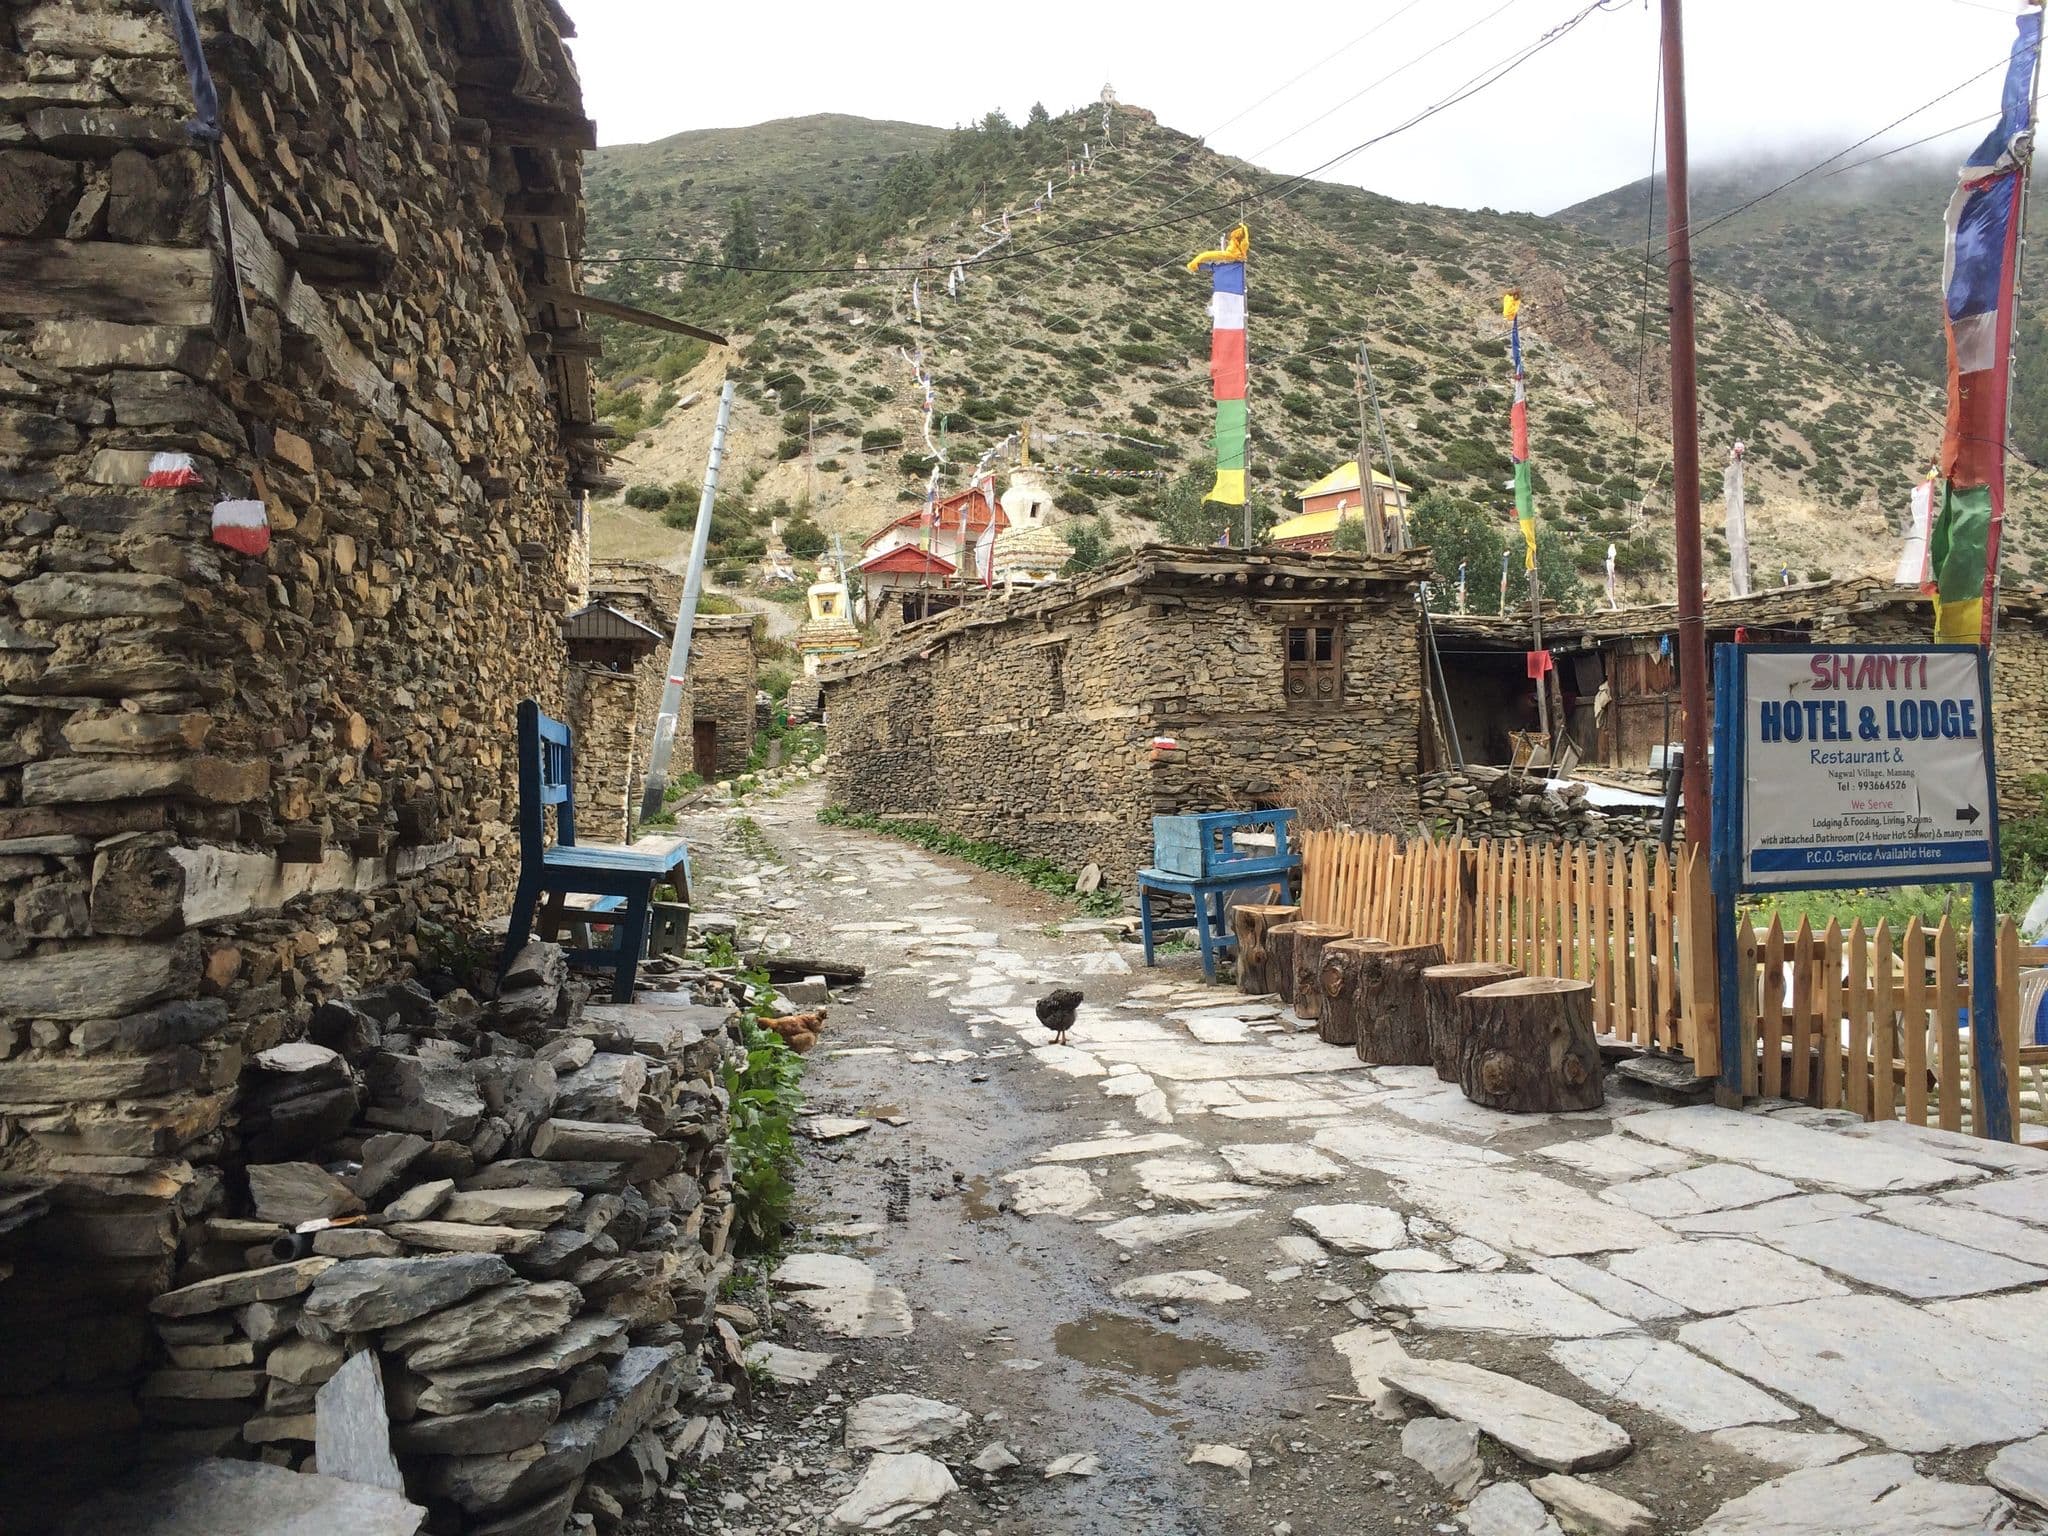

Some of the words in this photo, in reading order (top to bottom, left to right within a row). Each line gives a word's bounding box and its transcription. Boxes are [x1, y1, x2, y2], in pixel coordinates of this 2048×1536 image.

[1810, 654, 1928, 690] SHANTI
[1761, 700, 1852, 743] HOTEL
[1859, 706, 1881, 741] &
[1886, 699, 1977, 741] LODGE
[1811, 749, 1890, 764] Restaurant
[1893, 747, 1904, 763] &
[1887, 768, 1915, 778] Manang
[1851, 800, 1865, 810] We
[1868, 799, 1894, 810] Serve
[1812, 817, 1842, 829] Lodging
[1843, 817, 1849, 826] &
[1850, 816, 1882, 828] Fooding,
[1883, 815, 1905, 826] Living
[1761, 835, 1777, 844] with
[1779, 833, 1814, 844] attached
[1815, 832, 1855, 843] Bathroom
[1855, 831, 1870, 844] (24
[1872, 831, 1890, 841] Hour
[1892, 829, 1906, 840] Hot
[1943, 829, 1964, 839] many
[1965, 828, 1983, 838] more
[1836, 849, 1873, 862] Service
[1874, 847, 1917, 861] Available
[1919, 847, 1942, 858] Here
